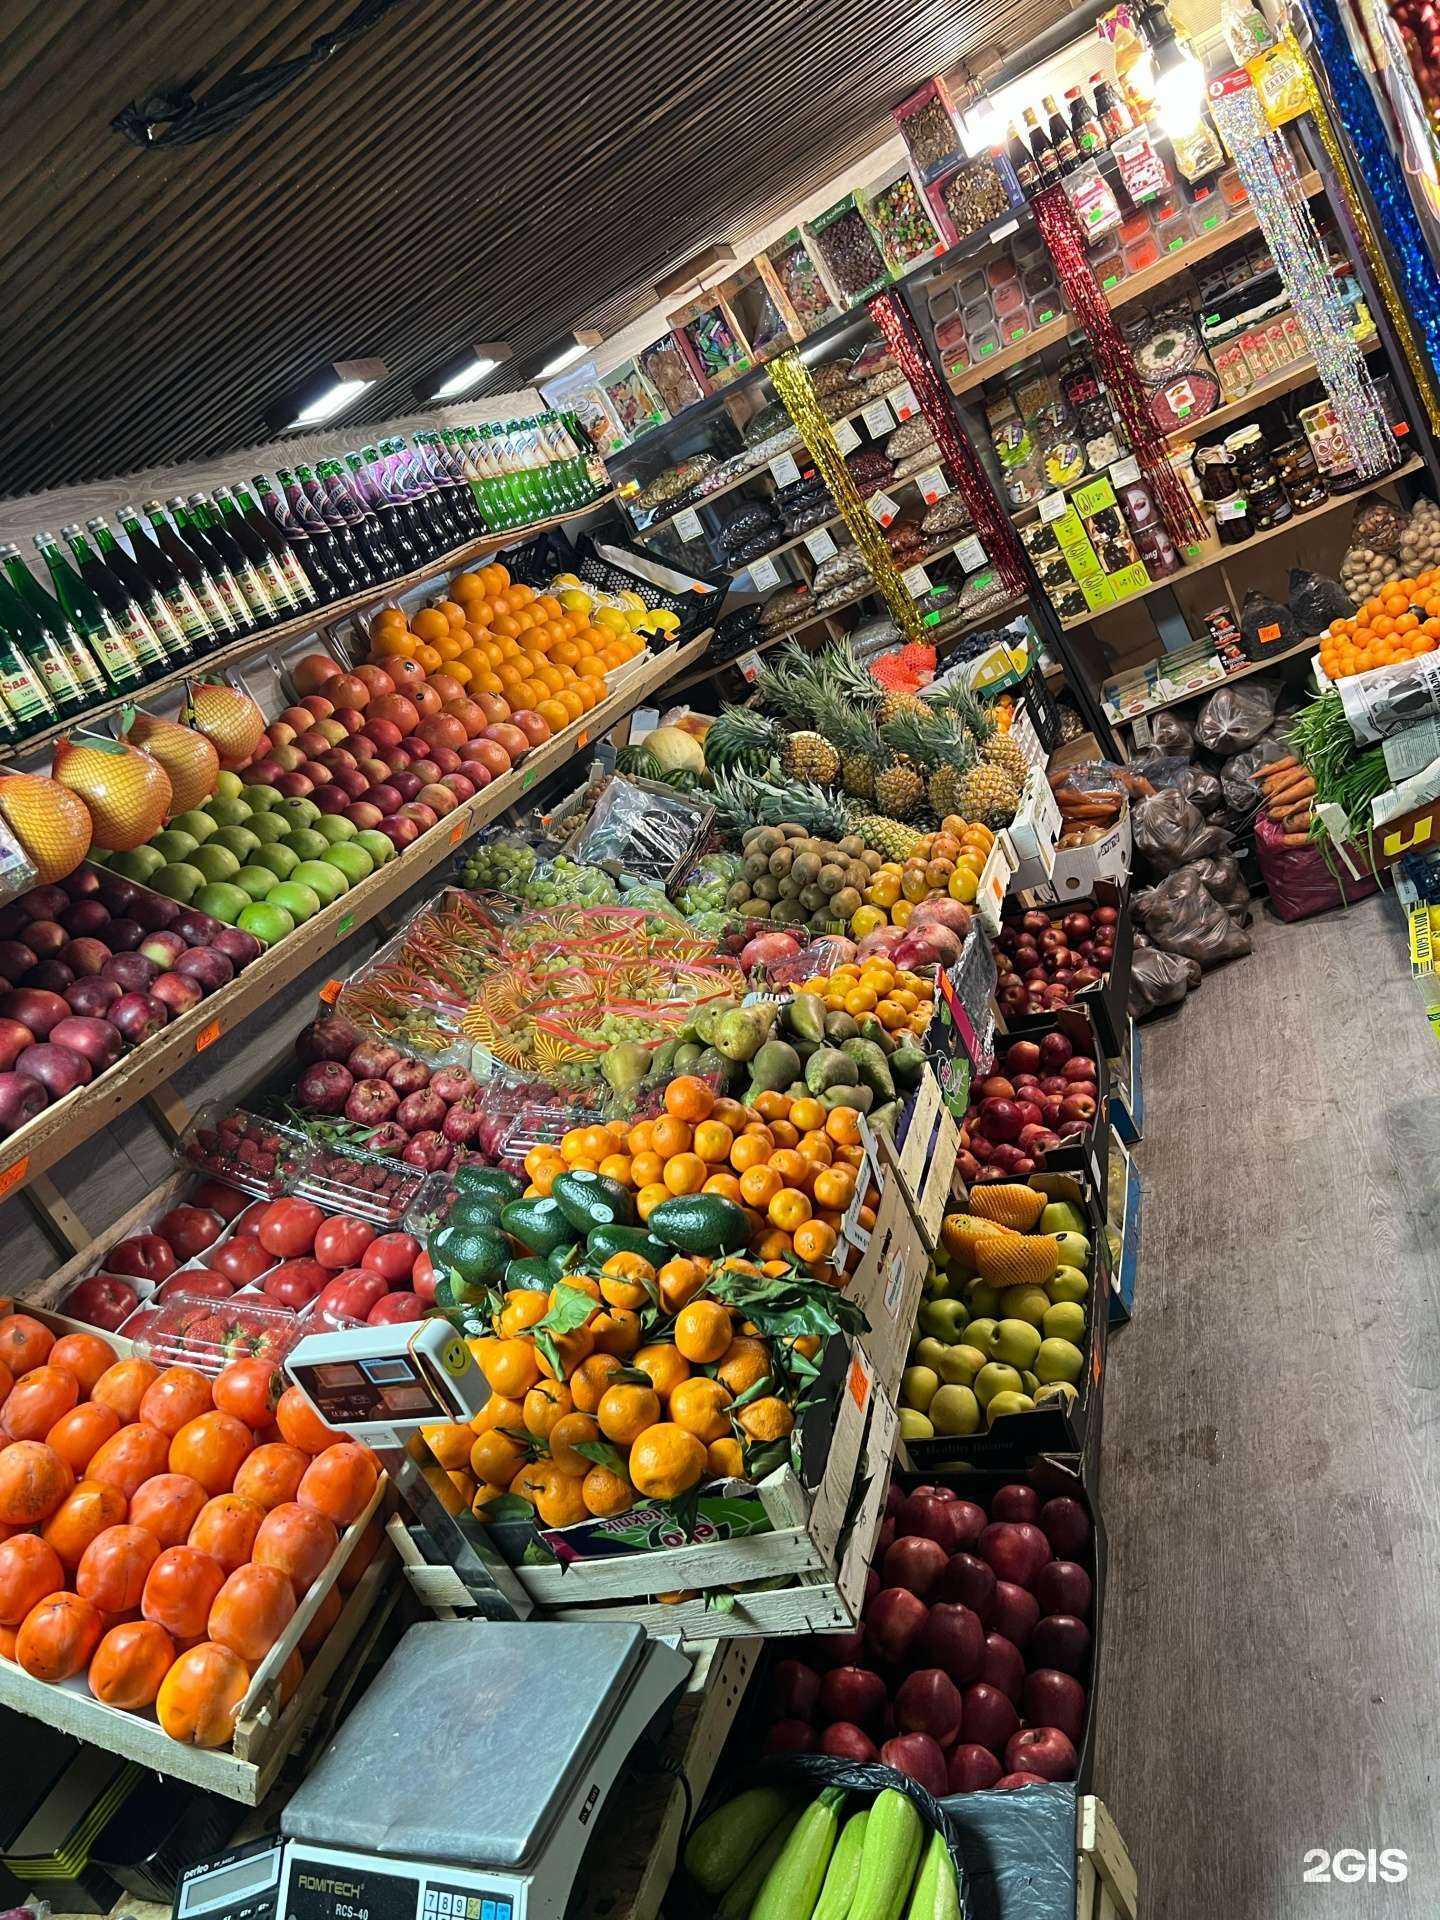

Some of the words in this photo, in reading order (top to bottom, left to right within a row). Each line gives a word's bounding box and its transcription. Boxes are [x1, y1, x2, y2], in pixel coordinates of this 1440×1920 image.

[1414, 912, 1429, 938] ROYAL
[1416, 937, 1430, 959] GOLD
[599, 1508, 665, 1534] teknik
